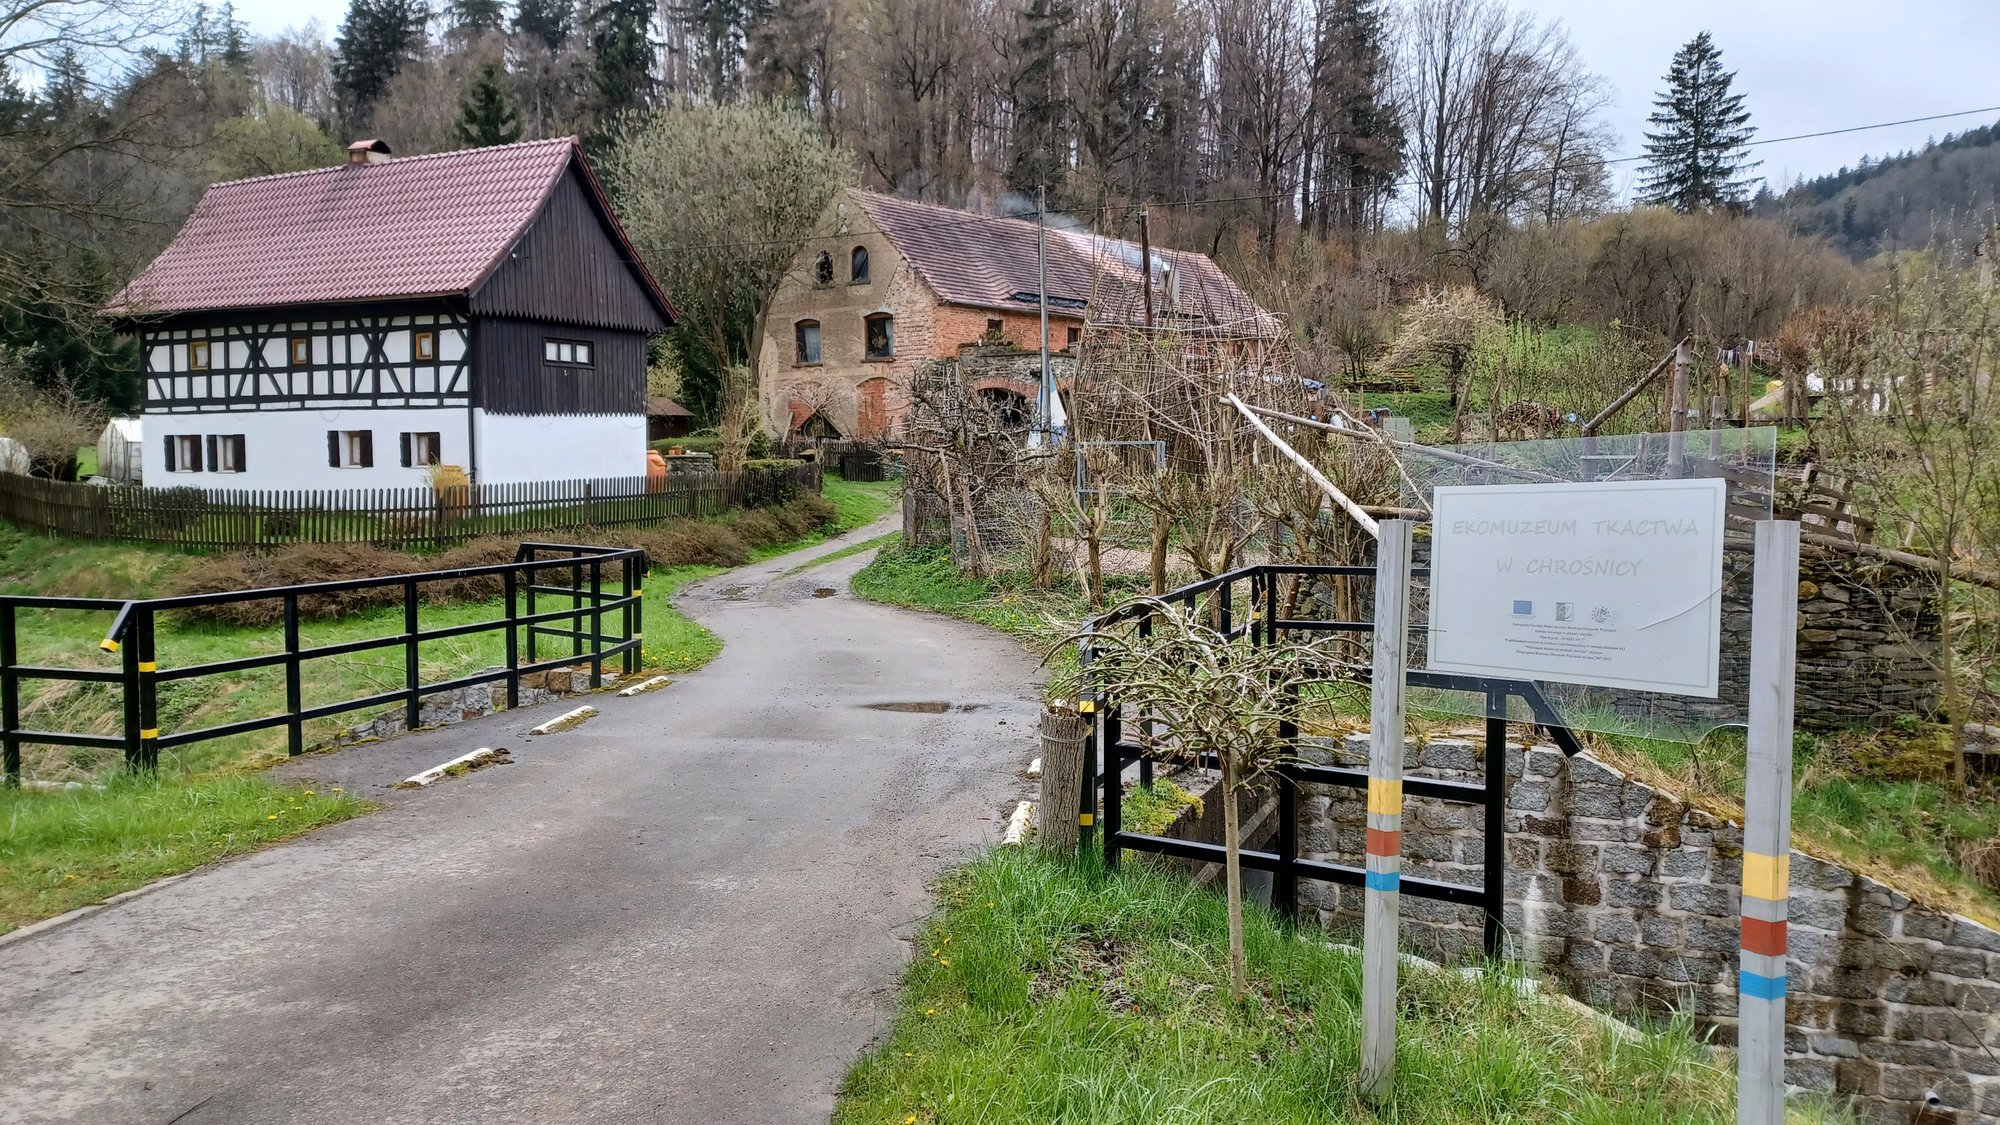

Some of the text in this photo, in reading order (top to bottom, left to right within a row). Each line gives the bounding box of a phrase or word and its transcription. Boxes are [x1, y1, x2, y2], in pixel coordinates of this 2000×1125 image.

[1452, 518, 1699, 536] EKOMUZEUM TKACTWA
[1496, 555, 1643, 577] W CHROŚNICY
